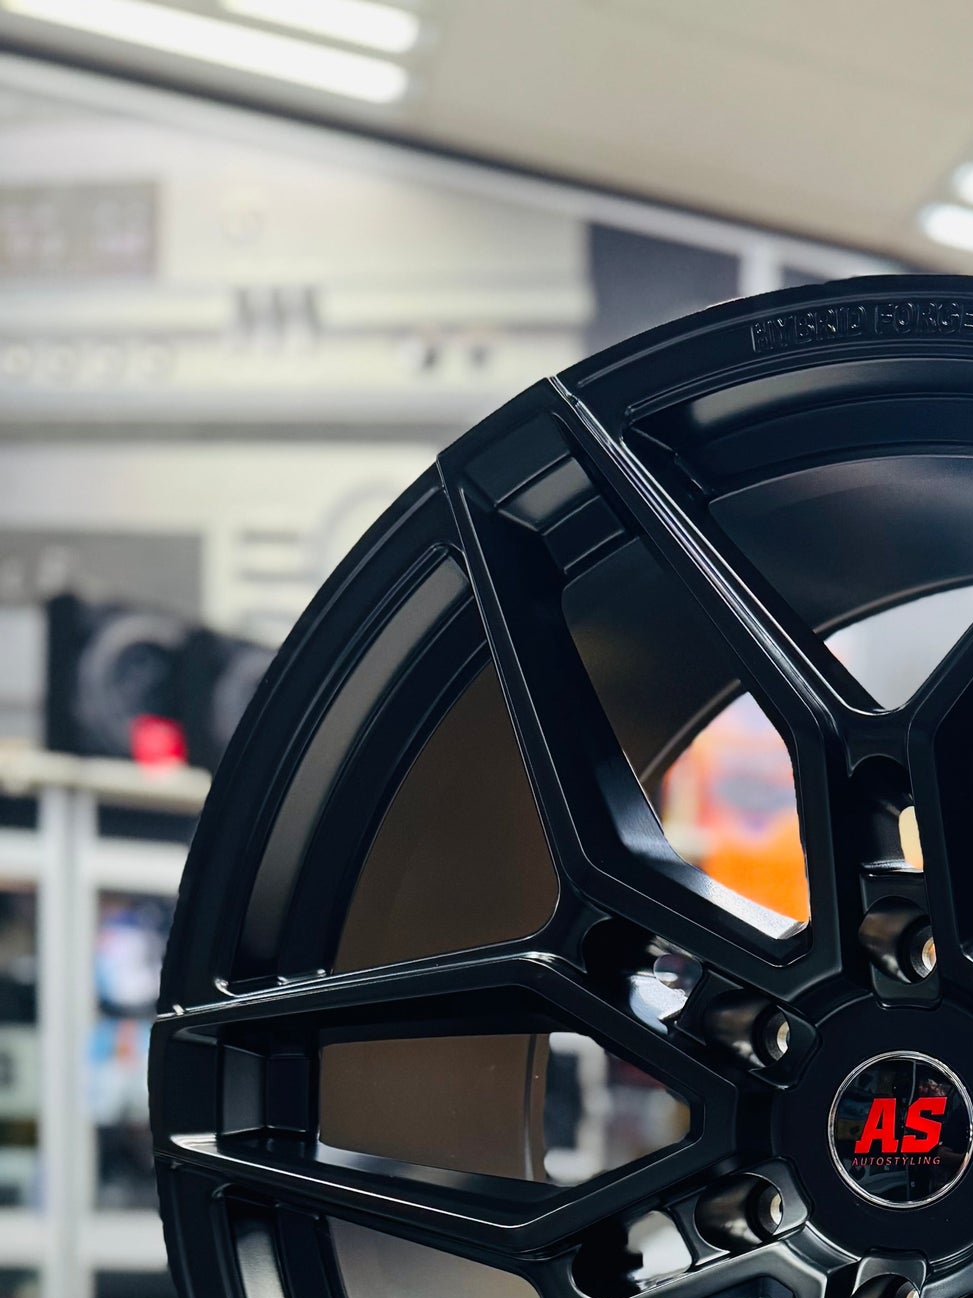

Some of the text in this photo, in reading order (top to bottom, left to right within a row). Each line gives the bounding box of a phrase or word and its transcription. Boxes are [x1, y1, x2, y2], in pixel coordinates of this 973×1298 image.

[751, 305, 866, 352] HYBRID
[854, 1097, 947, 1154] AS
[852, 1156, 941, 1166] AUTOSTYLING
